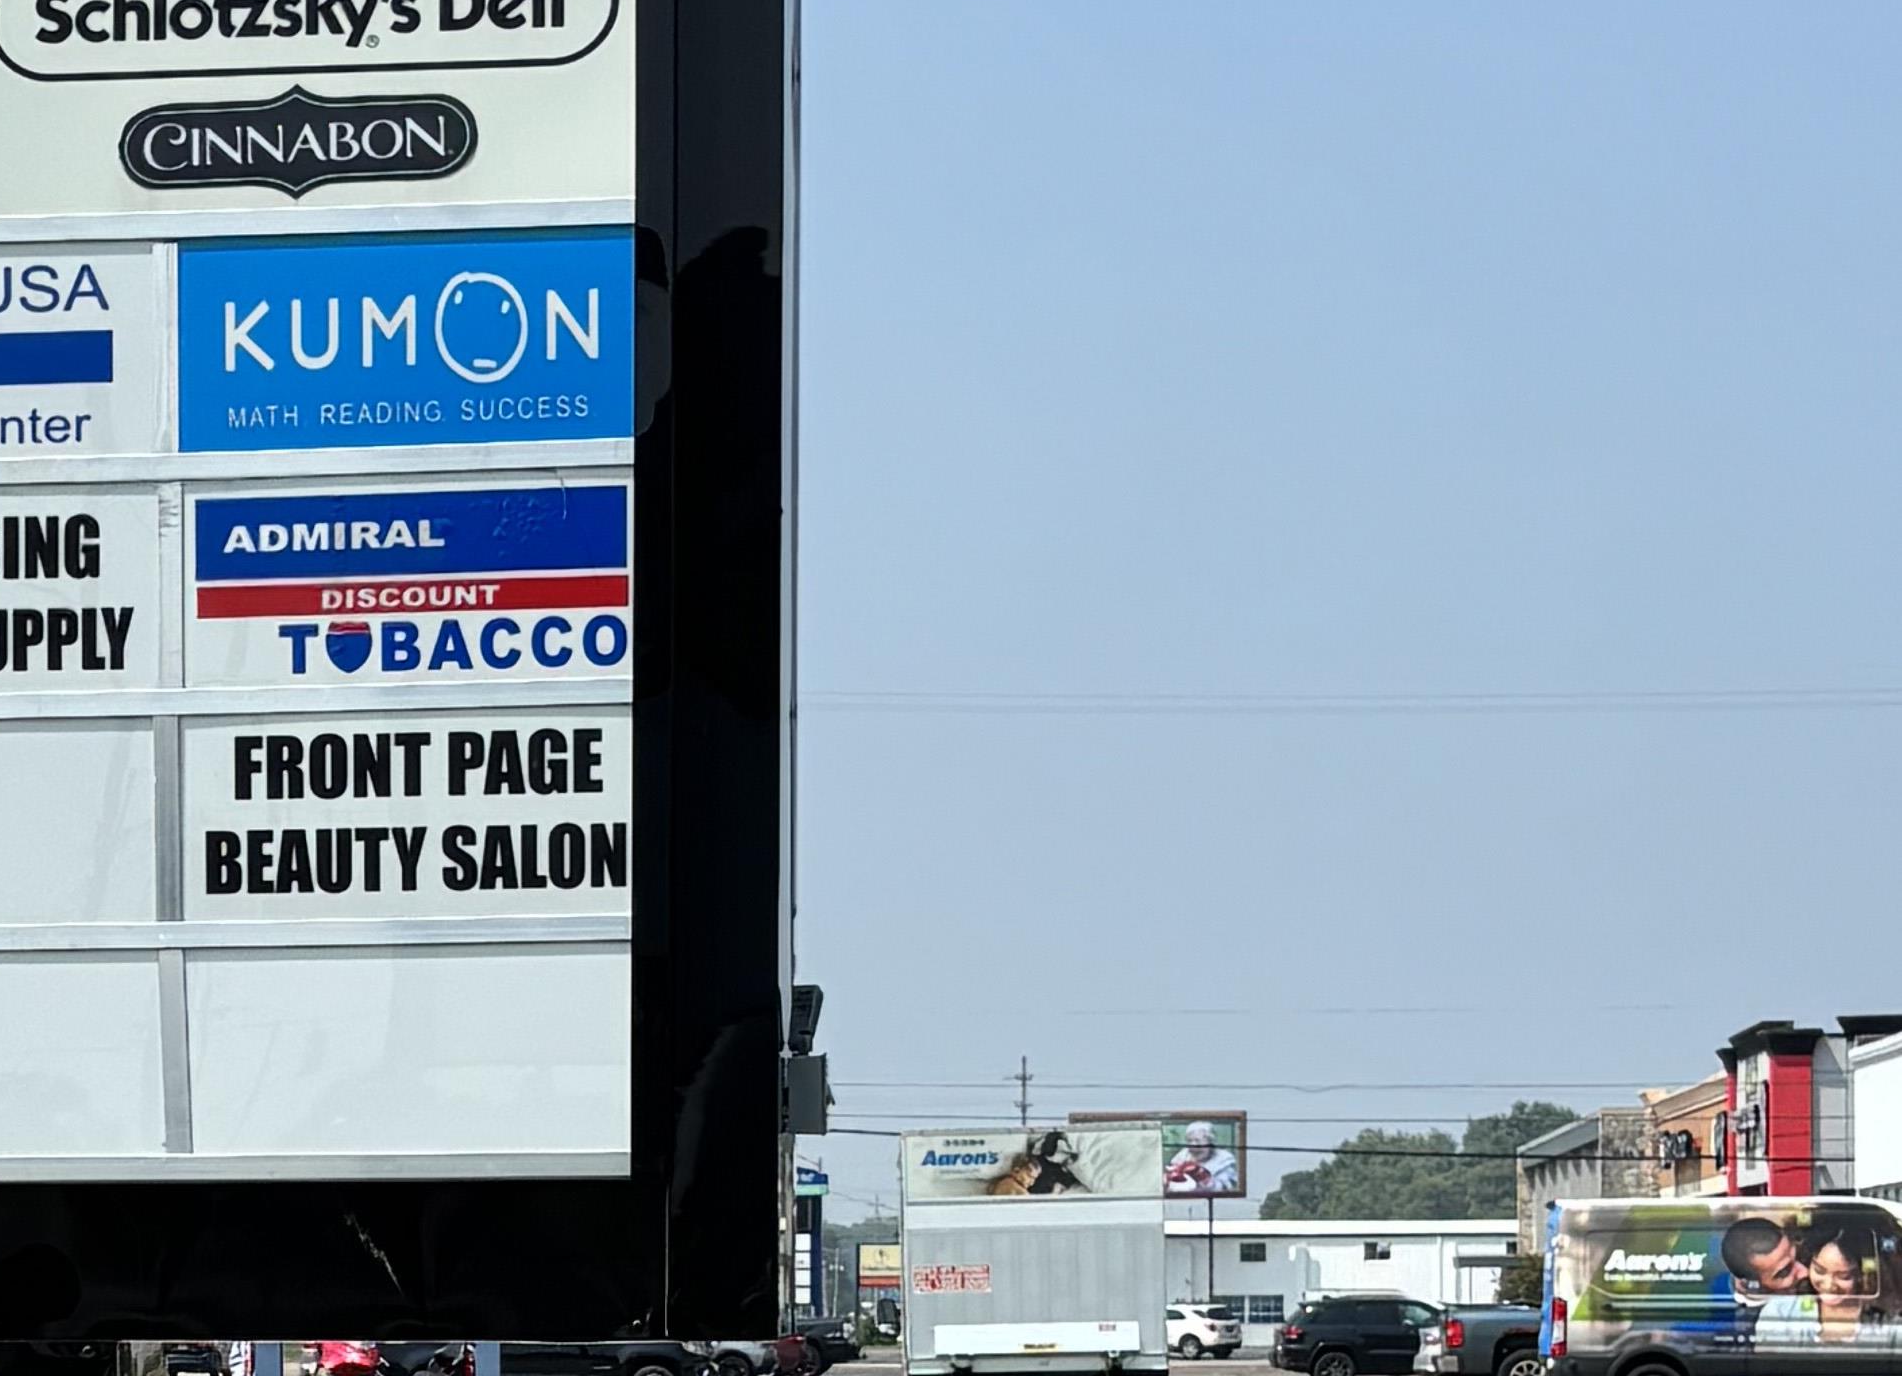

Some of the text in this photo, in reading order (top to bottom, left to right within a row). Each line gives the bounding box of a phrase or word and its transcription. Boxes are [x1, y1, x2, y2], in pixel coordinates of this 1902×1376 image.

[142, 114, 450, 172] CINNABON
[224, 270, 599, 384] KUMON
[223, 519, 446, 554] ADMIRAL
[321, 583, 501, 610] DISCOUNT
[233, 727, 604, 801] FRONT PAGE
[205, 822, 628, 895] BEAUTY SALON
[921, 1150, 1000, 1166] Aaron's
